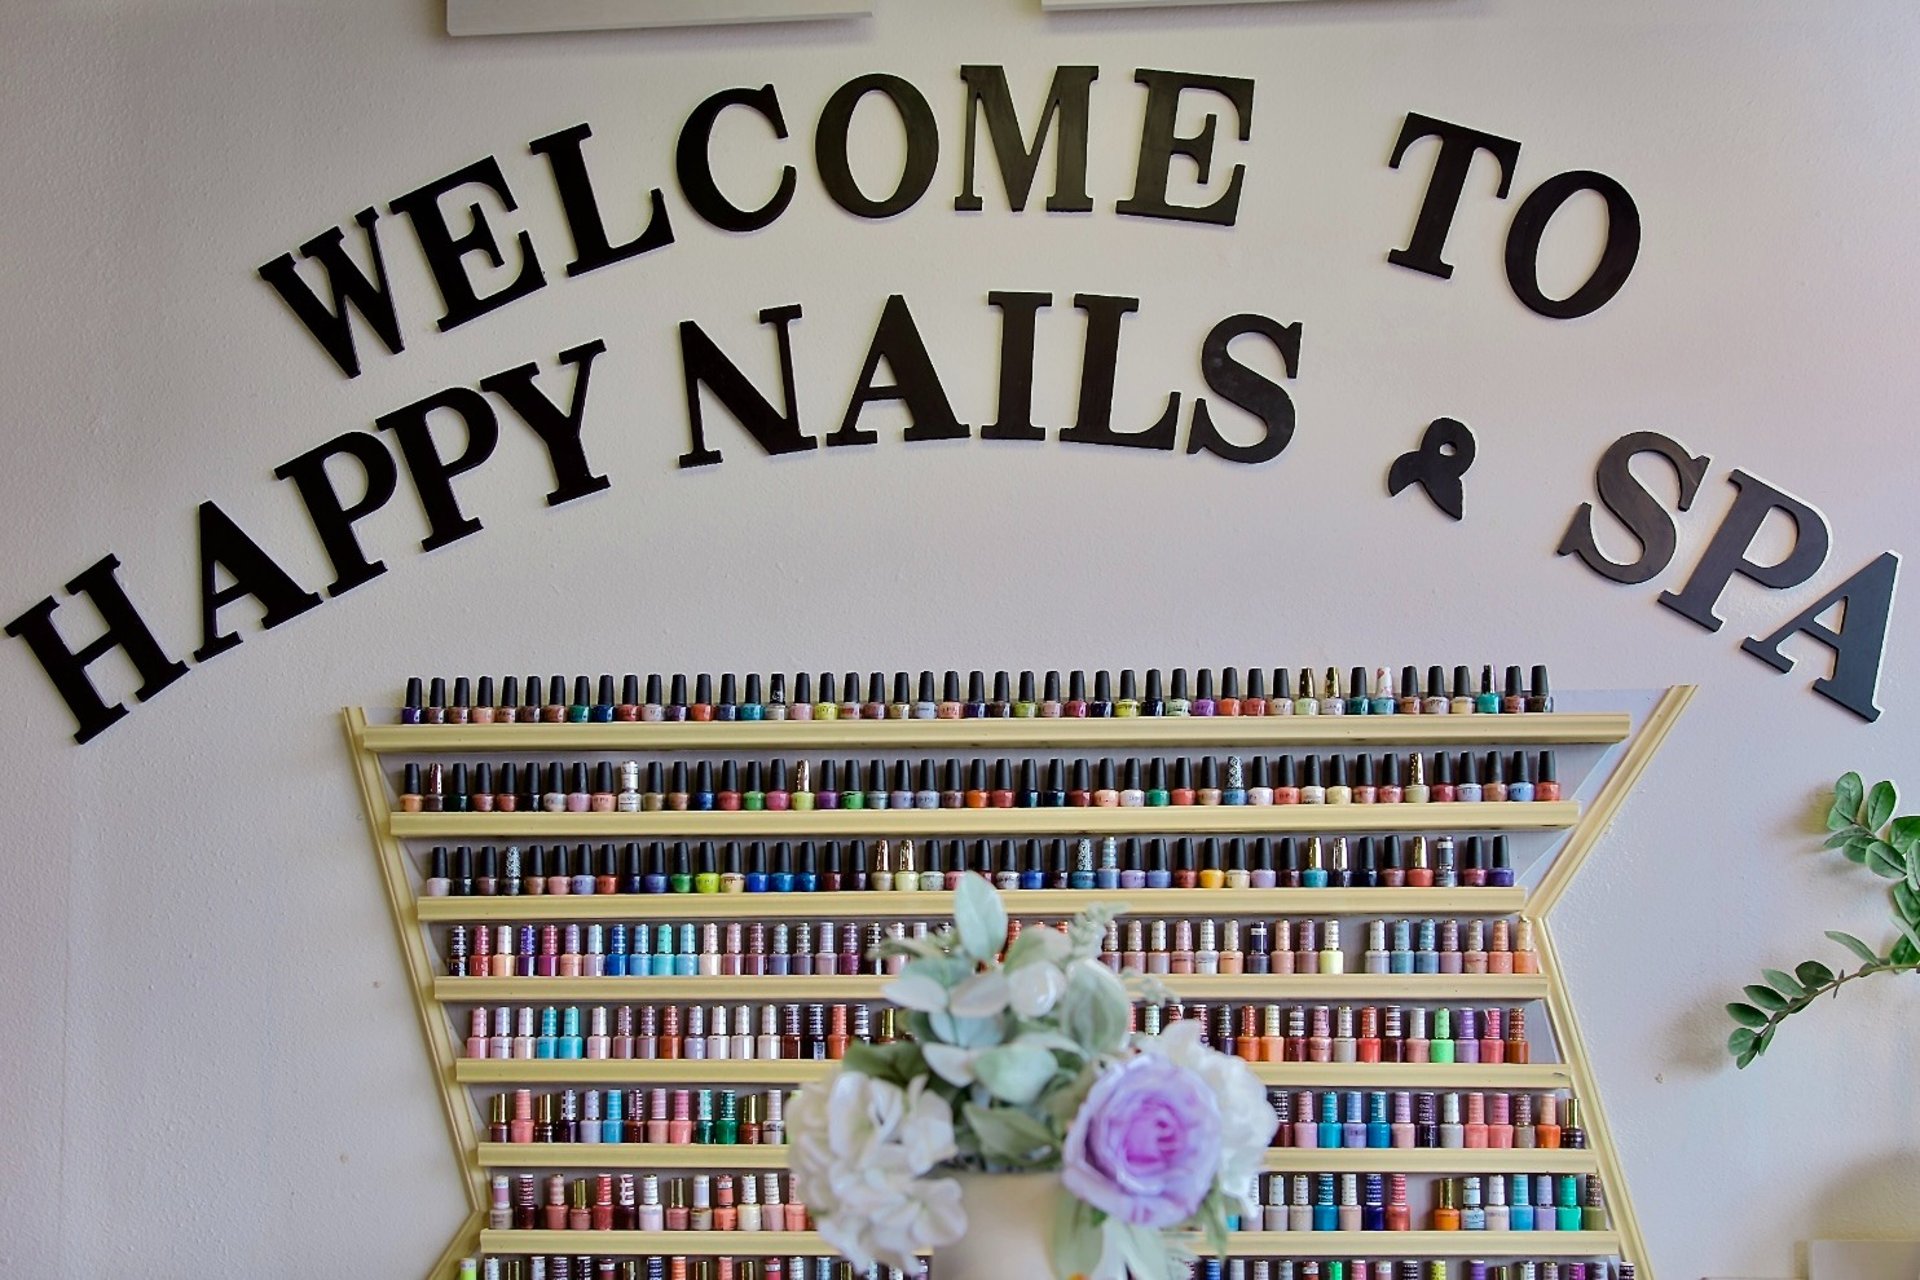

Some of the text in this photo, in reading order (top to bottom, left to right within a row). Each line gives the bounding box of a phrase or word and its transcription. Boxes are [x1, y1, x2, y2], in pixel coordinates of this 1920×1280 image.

[257, 65, 1640, 379] WELCOME TO
[4, 339, 611, 745] HAPPY
[679, 290, 1303, 468] NAILS
[1556, 432, 1900, 723] SPA
